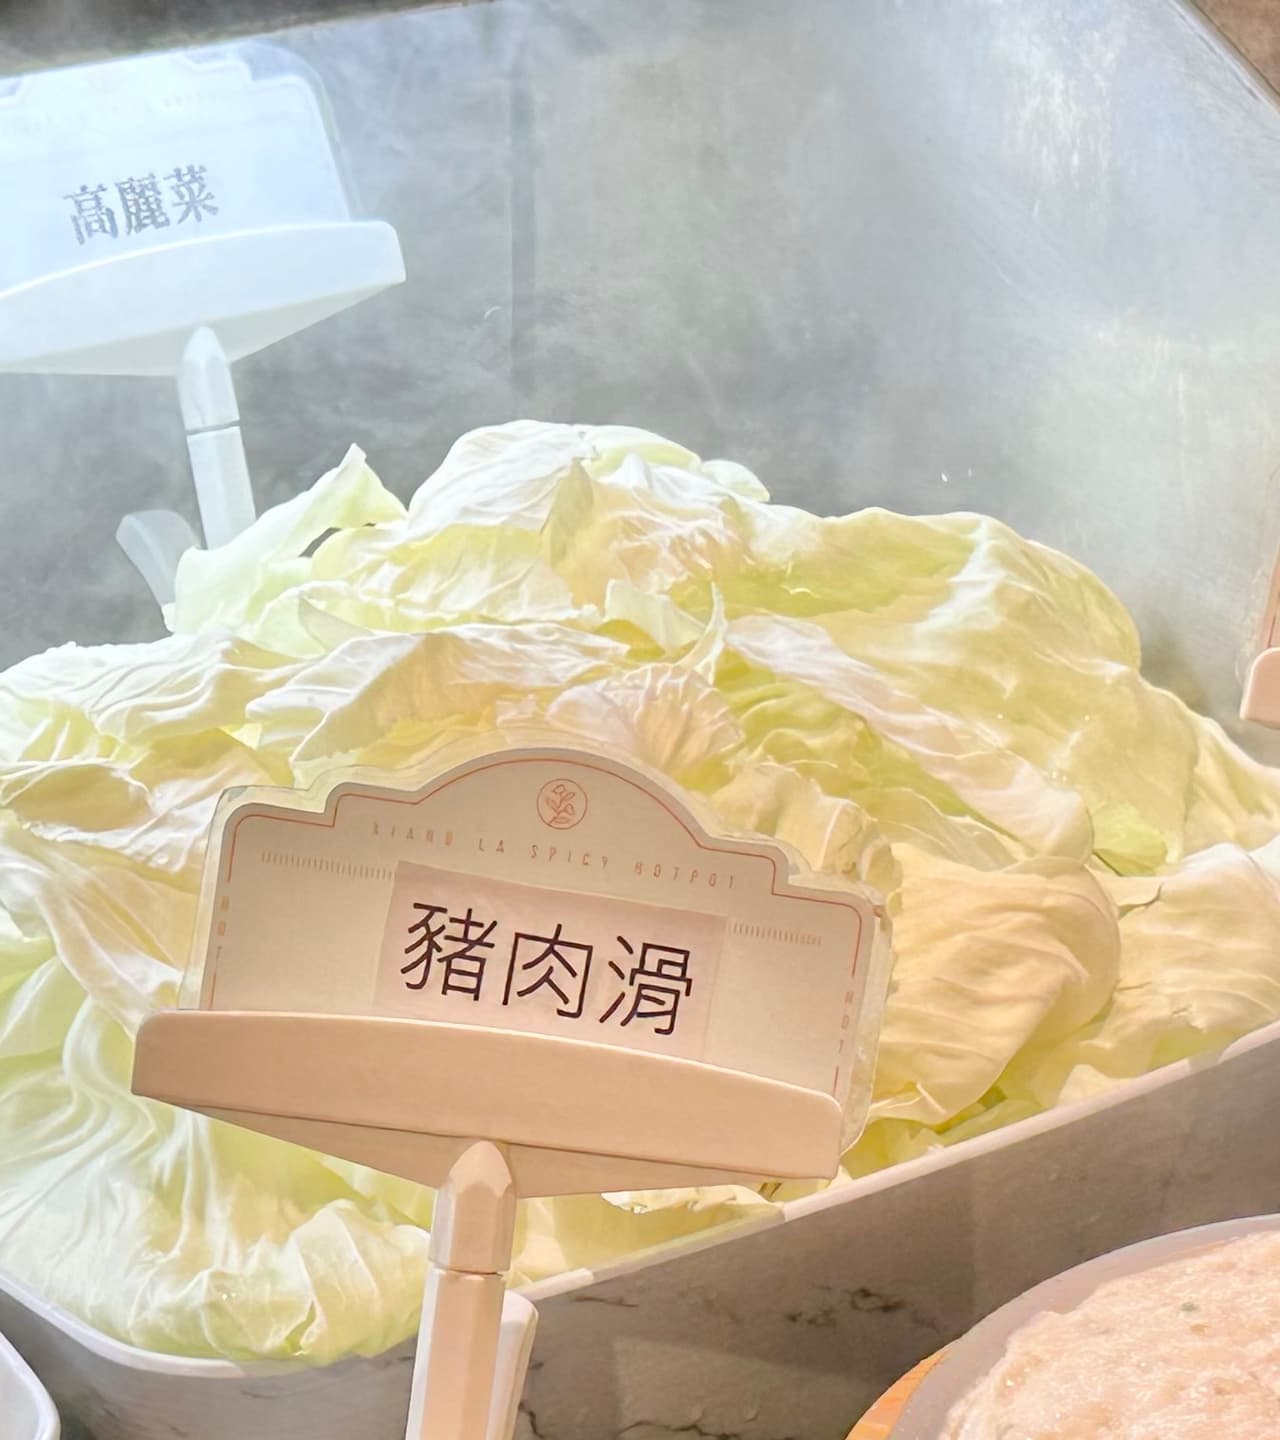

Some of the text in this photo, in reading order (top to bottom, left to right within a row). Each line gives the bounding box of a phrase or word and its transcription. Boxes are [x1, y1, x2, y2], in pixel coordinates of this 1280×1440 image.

[62, 163, 219, 245] 高麗菜
[478, 837, 505, 853] LA
[531, 844, 609, 870] SPICY
[400, 900, 693, 1037] 豬肉滑
